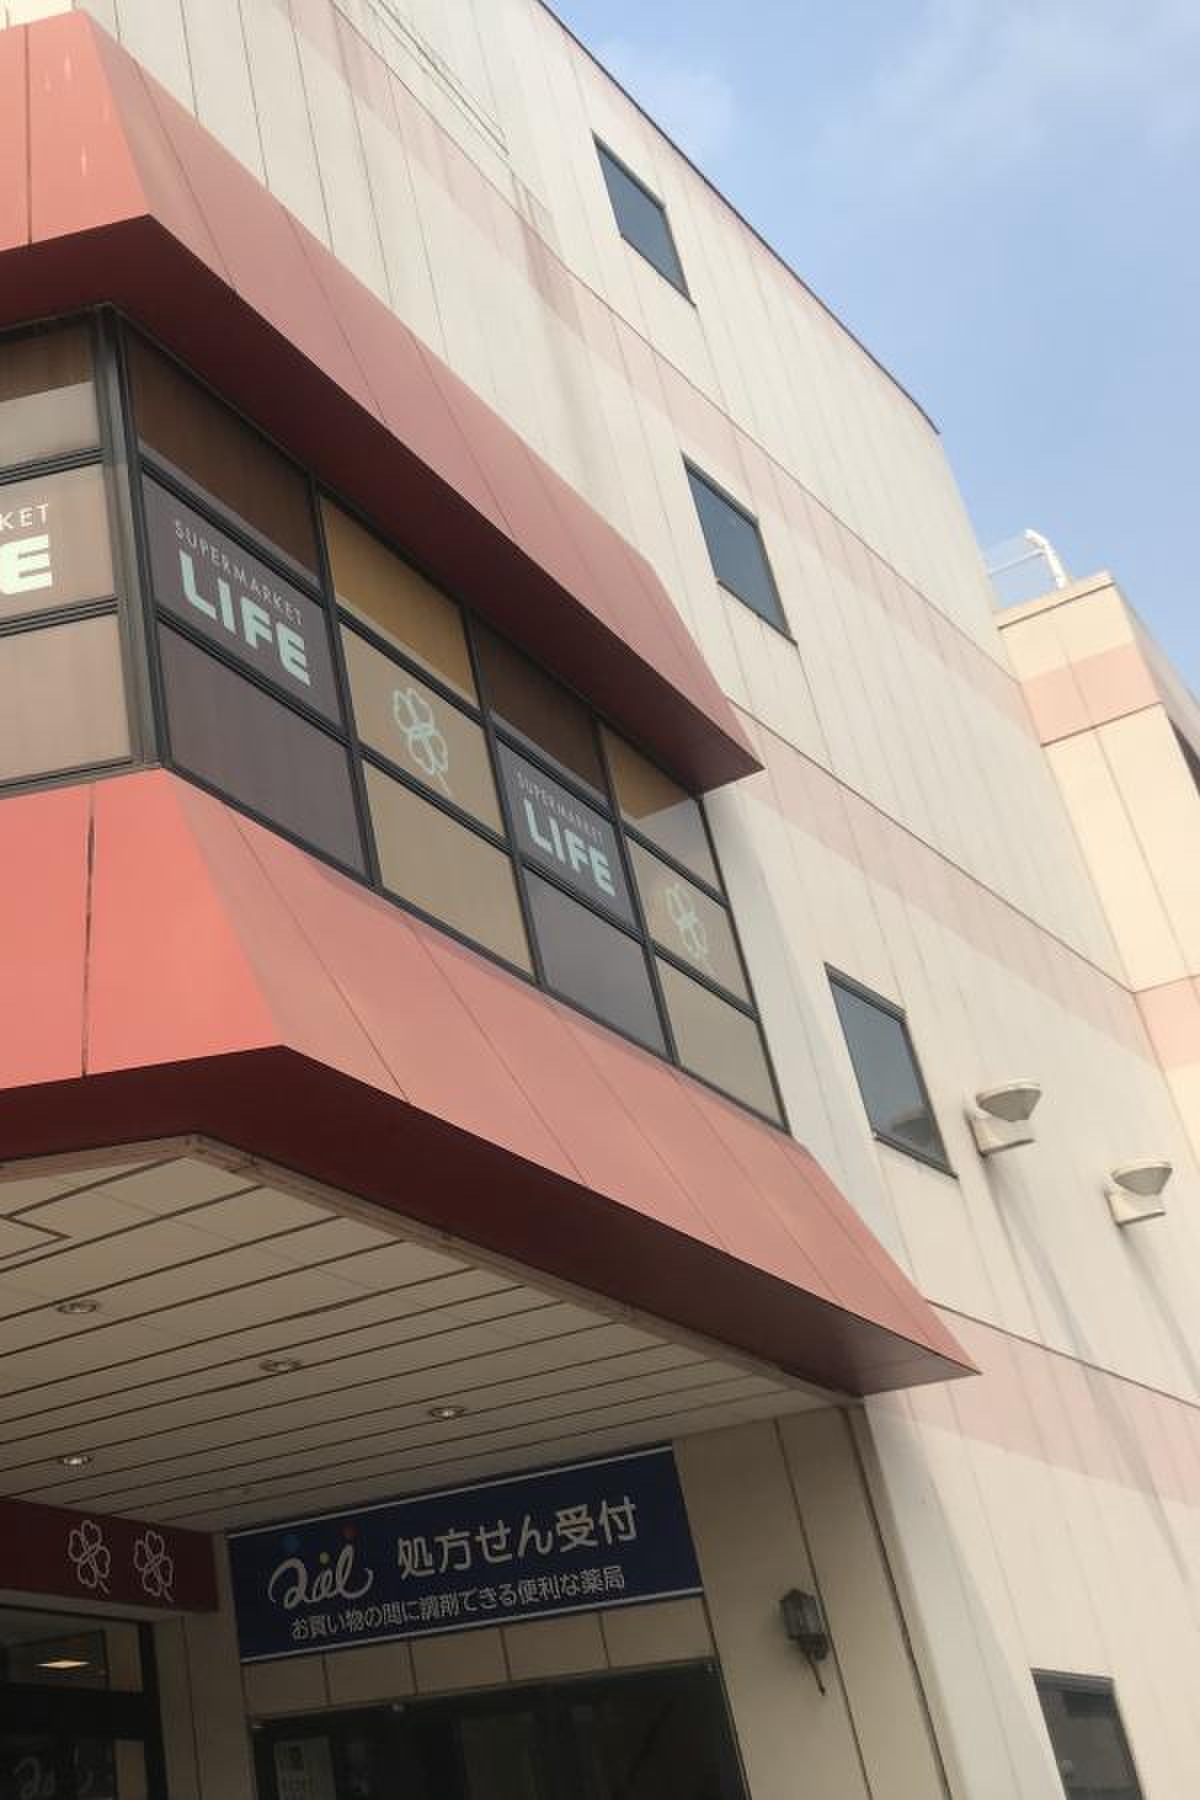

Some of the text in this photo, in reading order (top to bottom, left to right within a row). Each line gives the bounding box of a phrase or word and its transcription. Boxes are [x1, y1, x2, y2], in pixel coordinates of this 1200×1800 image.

[174, 518, 304, 626] SUPERMARKET
[179, 549, 311, 687] LIFE
[523, 799, 616, 897] LIFE
[397, 1497, 638, 1580] 処方せん受付
[292, 1566, 625, 1641] お買い物の間に調剤できる便利な薬局
